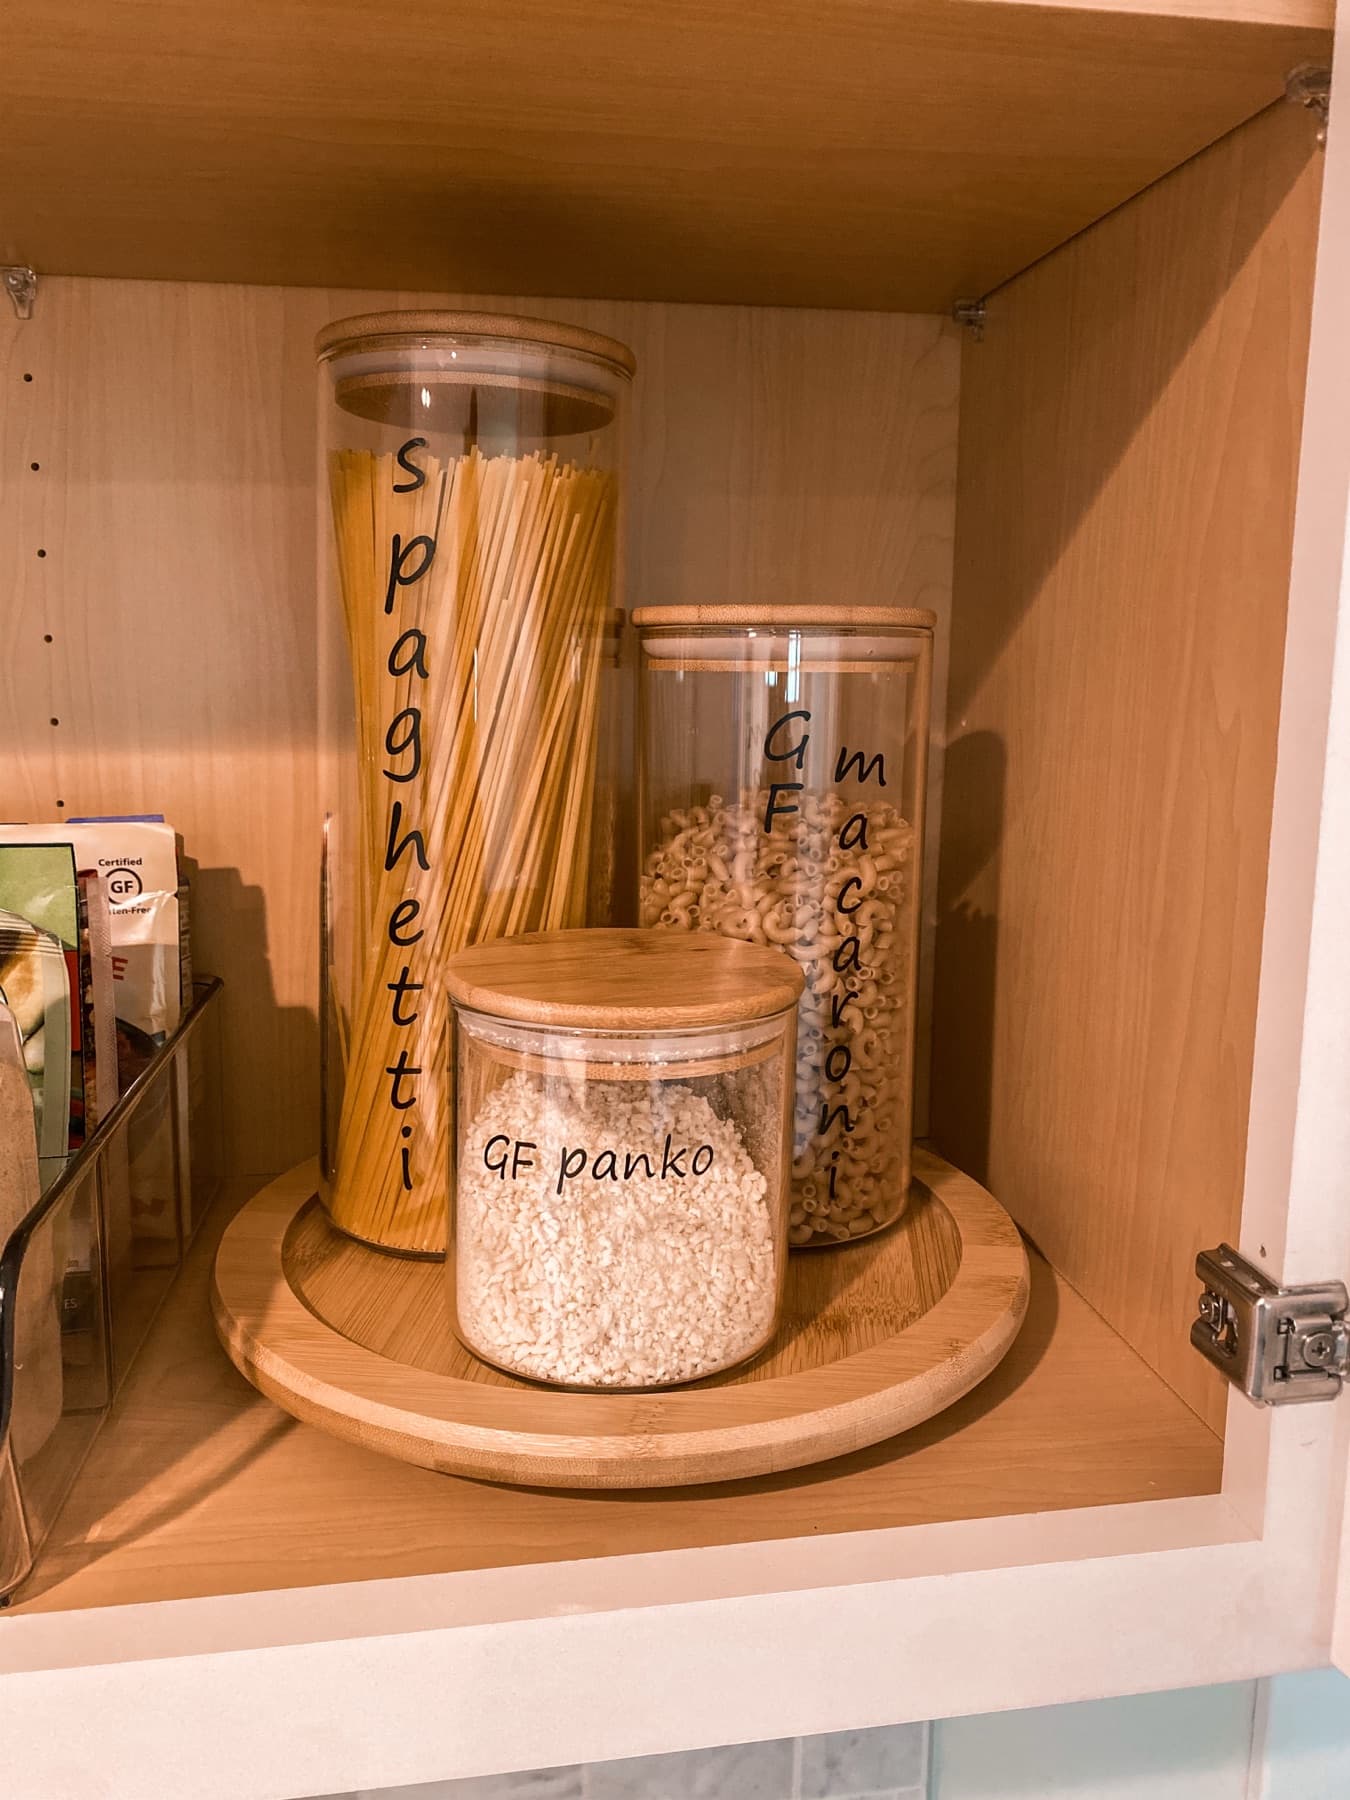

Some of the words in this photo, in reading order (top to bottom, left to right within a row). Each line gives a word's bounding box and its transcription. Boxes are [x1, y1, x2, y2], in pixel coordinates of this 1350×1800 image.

[383, 437, 436, 1190] spaghetti
[98, 857, 143, 867] Certified
[110, 880, 134, 894] GF
[818, 746, 886, 1199] macaroni
[483, 1134, 538, 1180] GF
[556, 1133, 714, 1195] panko
